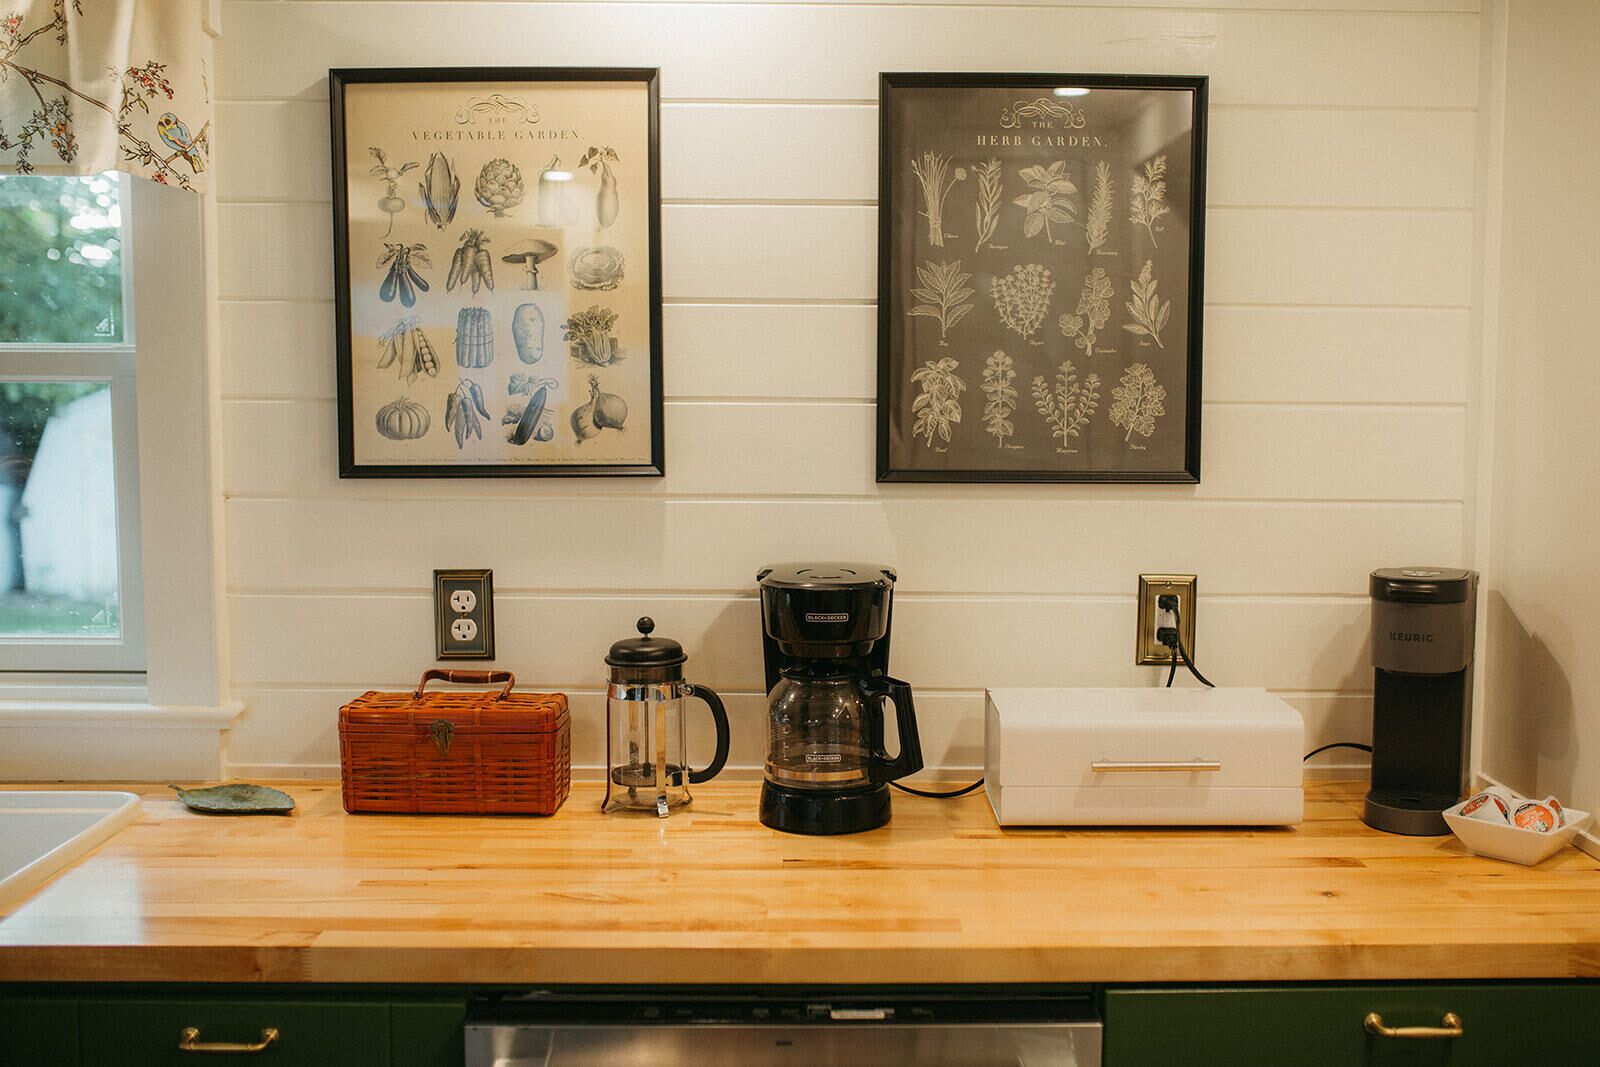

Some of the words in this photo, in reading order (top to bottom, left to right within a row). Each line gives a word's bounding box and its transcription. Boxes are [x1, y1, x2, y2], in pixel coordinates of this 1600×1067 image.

[1031, 121, 1054, 129] THE
[410, 130, 507, 141] VEGETABLE
[514, 130, 586, 141] GARDEN.
[976, 135, 1023, 146] HERB
[1031, 135, 1109, 148] GARDEN.
[1389, 631, 1433, 643] KEURIG
